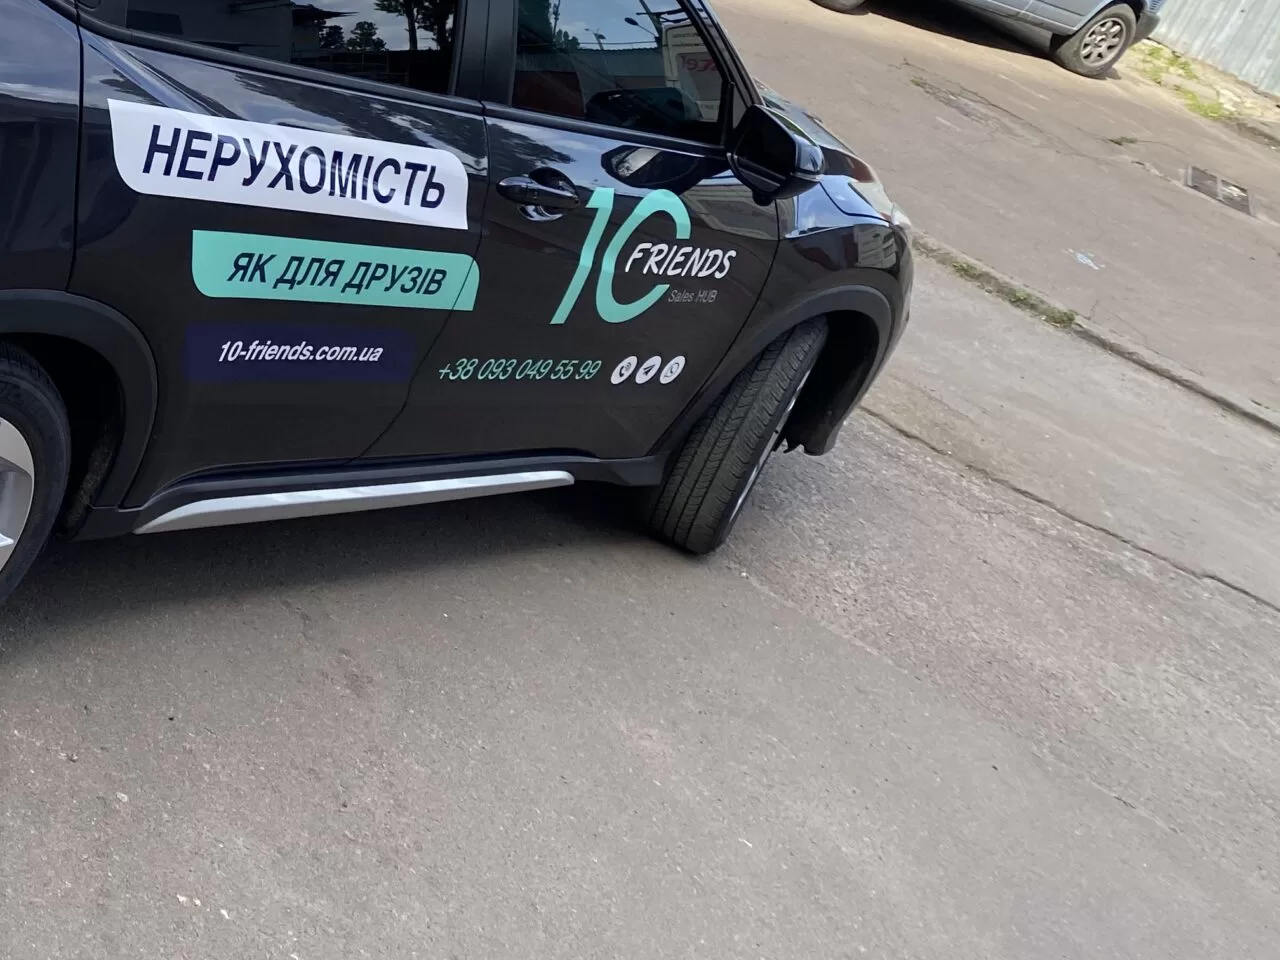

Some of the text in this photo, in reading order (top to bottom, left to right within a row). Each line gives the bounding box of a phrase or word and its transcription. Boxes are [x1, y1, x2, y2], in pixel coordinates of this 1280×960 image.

[142, 124, 446, 209] НЕРУХОМІСТЬ
[227, 252, 448, 295] ЯК ДЛЯ ДРУЗІВ
[624, 242, 737, 279] FRIENDS
[668, 288, 718, 304] Sales HUB
[218, 340, 384, 363] 10-friends.com.ua
[438, 358, 602, 380] +38 093 049 55 99
